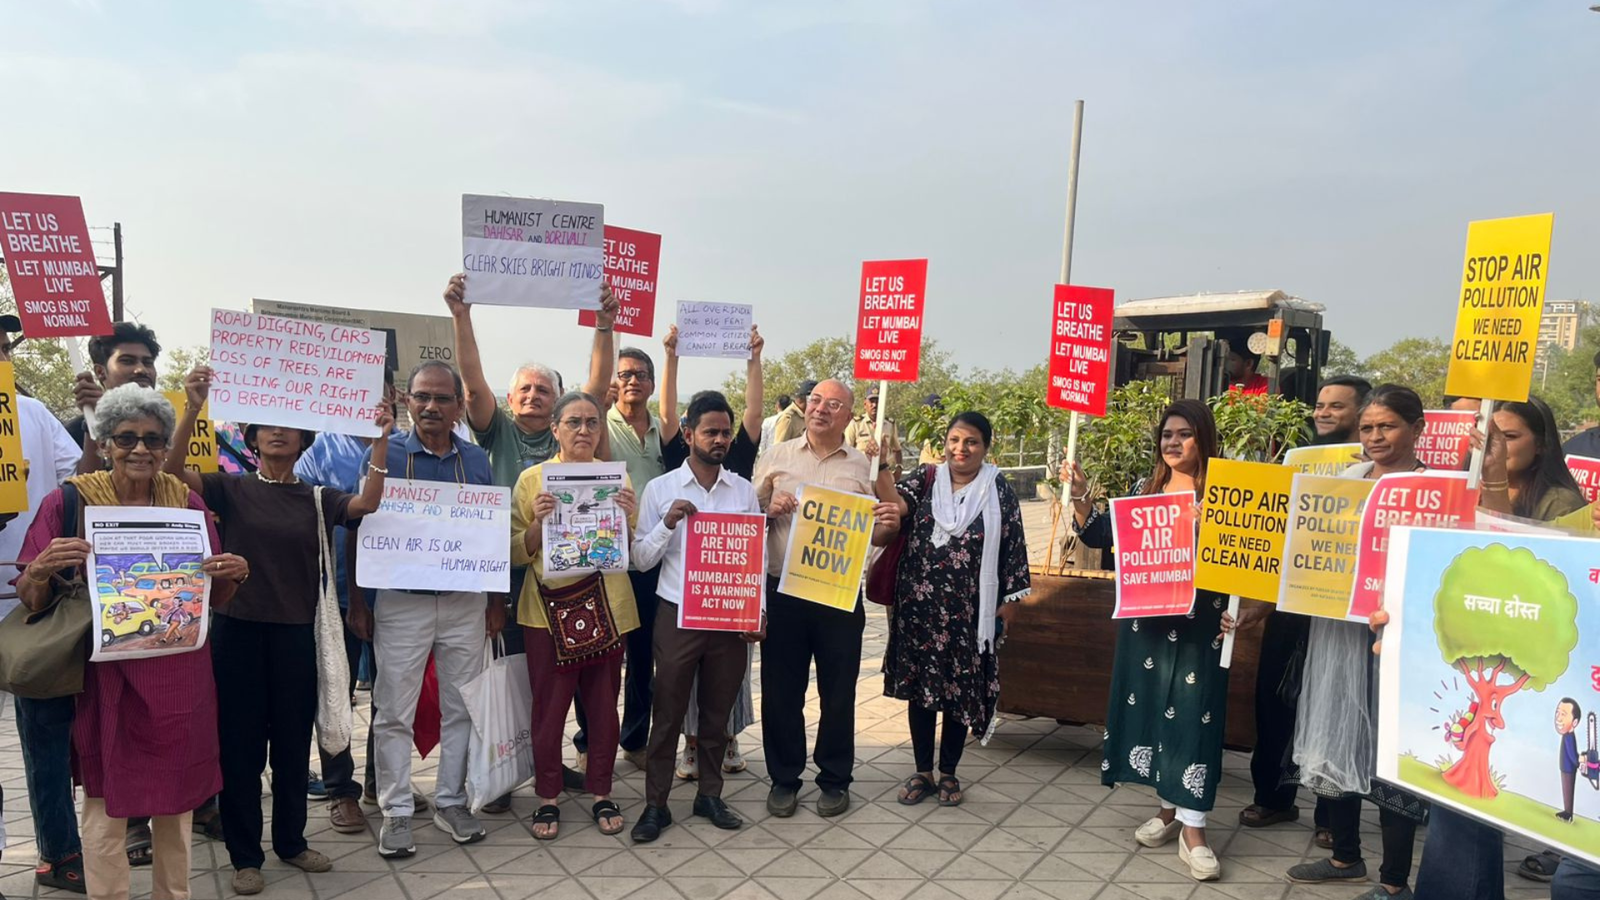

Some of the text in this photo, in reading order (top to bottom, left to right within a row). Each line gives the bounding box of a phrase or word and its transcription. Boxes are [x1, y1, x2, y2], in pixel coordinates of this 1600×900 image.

[2, 212, 59, 232] LET US
[485, 209, 595, 230] HUMANIST CENTRE
[8, 234, 82, 253] BREATHE
[484, 225, 588, 246] DAHISAR AND BORIVALI
[619, 242, 635, 257] US
[14, 260, 95, 276] LET MUMBAI
[464, 254, 497, 273] CLEAR
[500, 257, 527, 275] SKIES
[531, 260, 566, 277] BRIGHT
[569, 262, 602, 280] MINDS
[603, 255, 649, 275] REATHE
[1466, 253, 1542, 283] STOP AIR
[44, 278, 74, 293] LIVE
[612, 275, 654, 292] MUMBAI
[866, 276, 904, 292] LET US
[614, 287, 632, 301] IVE
[864, 294, 915, 310] BREATHE
[1462, 286, 1539, 308] POLLUTION
[24, 300, 90, 314] SMOG IS NOT
[623, 306, 641, 317] NOT
[680, 303, 699, 314] ALL
[703, 305, 727, 314] OVER
[1057, 301, 1092, 320] LET US
[43, 315, 89, 327] NORMAL
[214, 311, 251, 327] ROAD
[257, 316, 326, 342] DIGGING,
[331, 327, 371, 344] CARS
[614, 316, 634, 327] MAL
[705, 318, 720, 326] BIG
[863, 316, 919, 329] LET MUMBAI
[1473, 318, 1522, 336] WE NEED
[678, 331, 717, 339] COMMON
[878, 330, 899, 343] LIVE
[1056, 320, 1103, 341] BREATHE
[212, 330, 283, 351] PROPERTY
[686, 342, 717, 350] CANNOT
[419, 346, 451, 360] ZERO
[860, 349, 907, 361] SMOG IS NOT
[1055, 341, 1107, 362] LET MUMBAI
[1455, 339, 1529, 364] CLEAN AIR
[211, 349, 247, 366] LOSS
[253, 356, 271, 369] OF
[326, 366, 356, 381] ARE
[869, 361, 901, 373] NORMAL
[1069, 359, 1088, 375] LIVE
[212, 371, 370, 403] KILLING OUR RIGHT
[1052, 376, 1095, 393] SMOG IS NOT
[211, 388, 230, 403] TO
[238, 391, 303, 411] BREATHE
[310, 400, 352, 418] CLEAN
[1060, 390, 1090, 405] NORMAL
[1432, 421, 1472, 436] LUNGS
[1414, 436, 1461, 450] RE NOT
[1415, 450, 1459, 466] ILTERS
[383, 486, 503, 506] UMANIST CENTRE
[1208, 485, 1290, 514] STOP AIR
[1299, 493, 1349, 515] STOP
[1378, 487, 1410, 507] LET
[1415, 489, 1441, 510] US
[423, 505, 442, 516] AND
[450, 507, 494, 521] BORIVALI
[803, 500, 869, 533] CLEAN
[1131, 504, 1181, 529] STOP
[1205, 508, 1287, 534] POLLUTION
[1374, 508, 1460, 528] BREATHE
[693, 520, 758, 537] OUR LUNGS
[1296, 516, 1359, 535] POLLUT
[362, 535, 462, 552] CLEAN AIR IS OUR
[701, 536, 749, 551] ARE NOT
[811, 526, 848, 552] AIR
[1141, 527, 1173, 550] AIR
[1218, 532, 1271, 553] WE NEED
[1311, 539, 1358, 555] WE NEE
[441, 557, 508, 573] HUMAN RIGHT
[701, 550, 748, 566] FILTERS
[801, 545, 852, 576] NOW
[1122, 547, 1191, 567] POLLUTION
[1201, 547, 1280, 575] CLEAN AIR
[1293, 554, 1346, 574] CLEAN
[744, 573, 761, 585] AQI
[1123, 569, 1192, 585] SAVE MUMBAI
[692, 584, 757, 598] IS A WARNING
[701, 598, 745, 610] ACT NOW
[1464, 594, 1541, 621] सच्चा दोस्त
